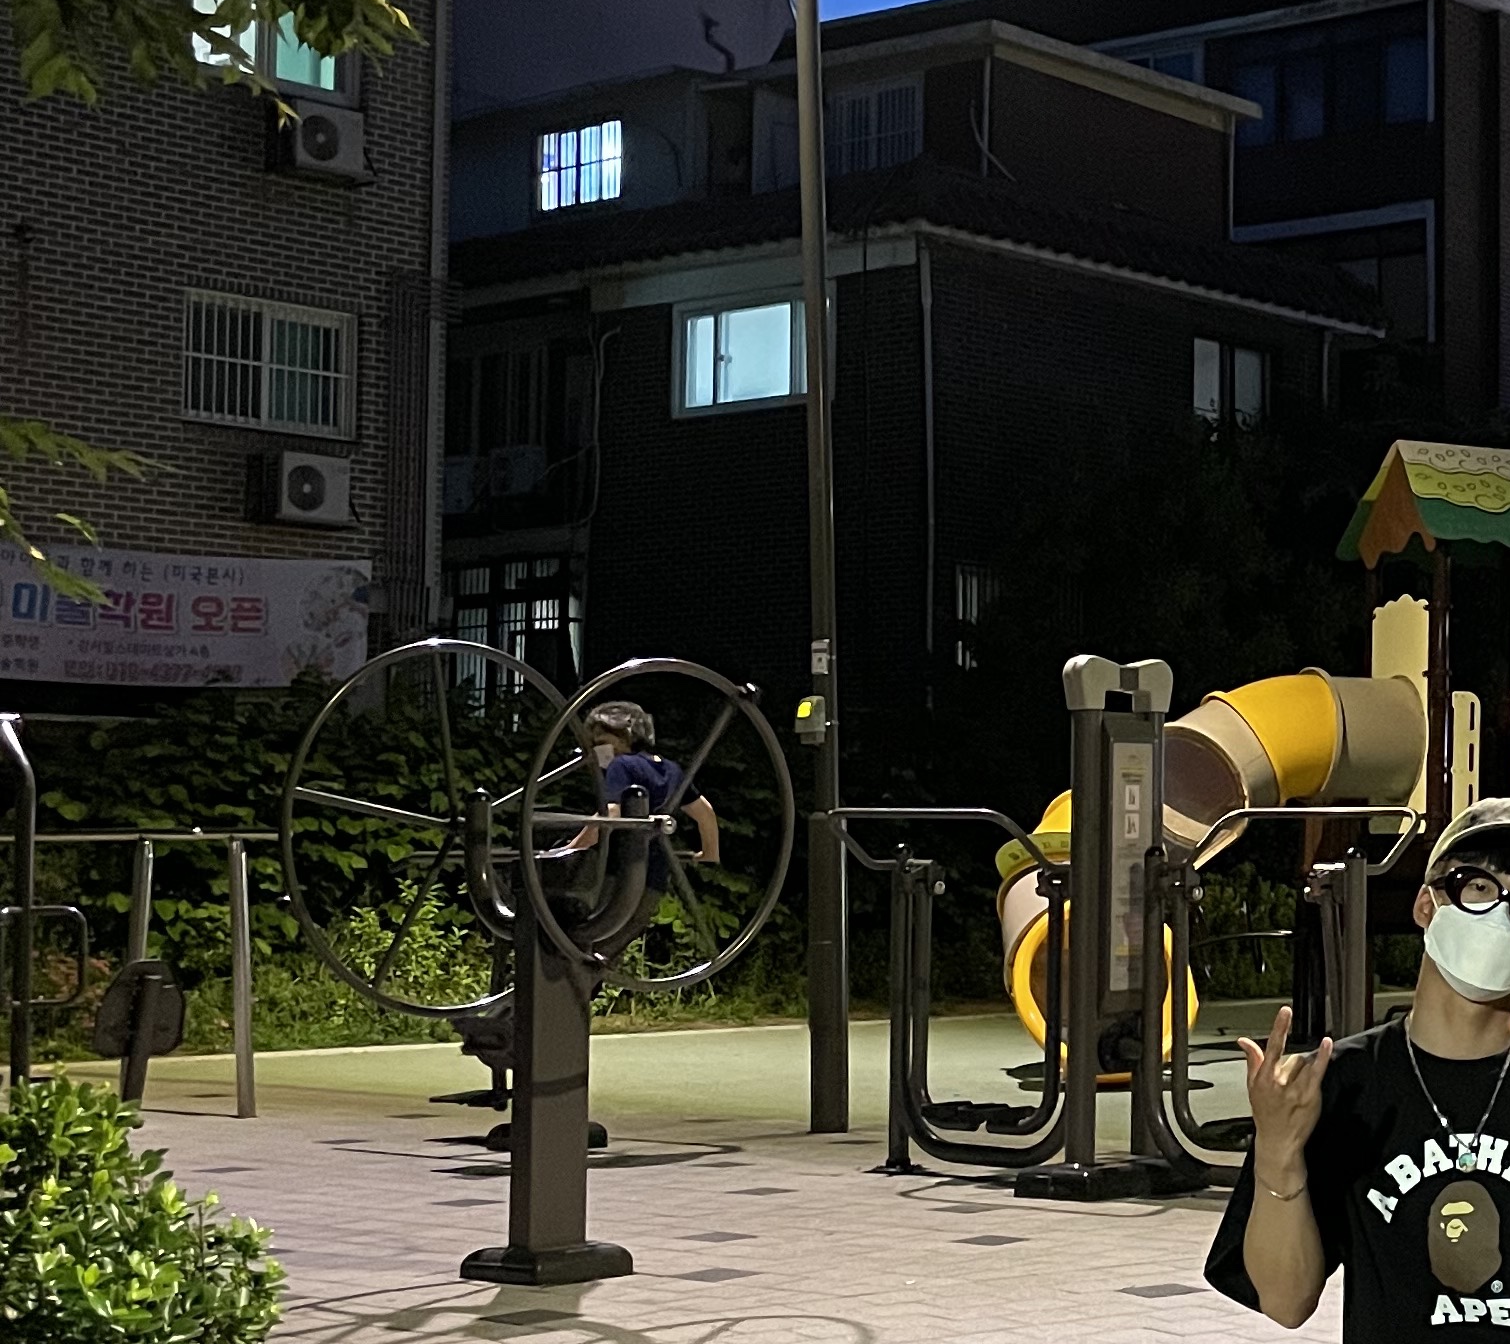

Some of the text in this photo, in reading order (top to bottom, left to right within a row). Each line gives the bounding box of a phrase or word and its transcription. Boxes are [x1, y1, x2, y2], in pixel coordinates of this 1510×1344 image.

[80, 556, 113, 577] 함께
[122, 560, 154, 582] 하는
[191, 595, 264, 633] 오픈
[1367, 1188, 1399, 1223] A
